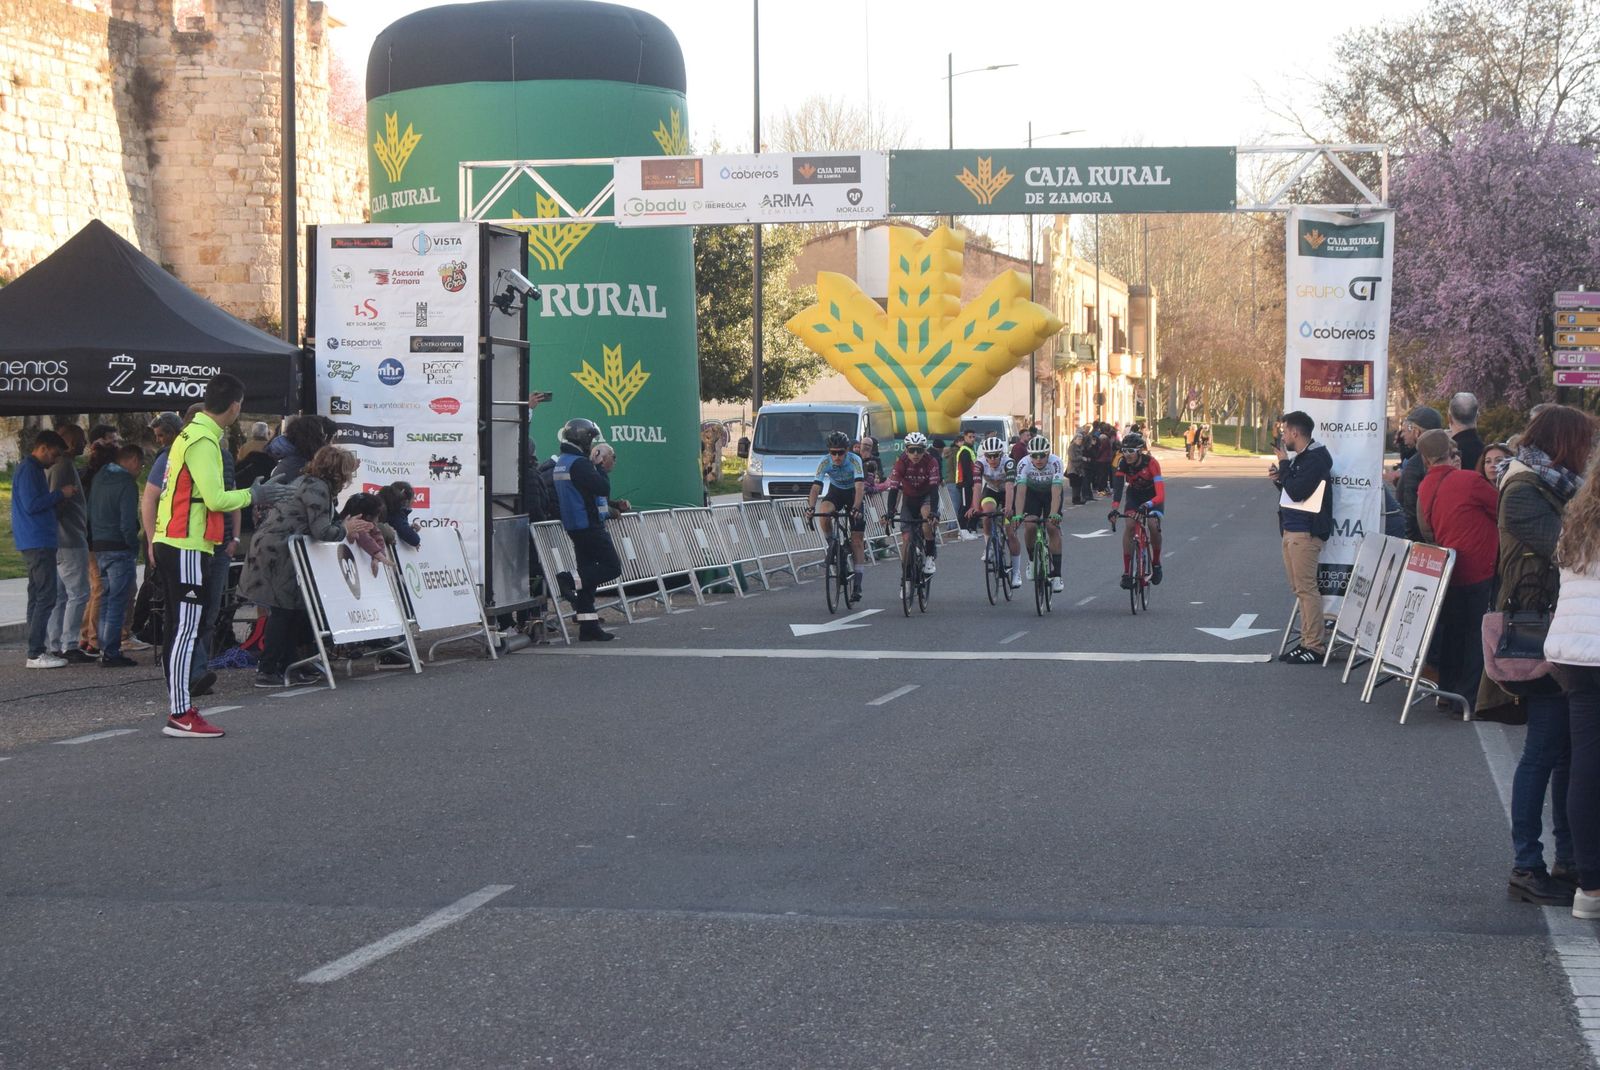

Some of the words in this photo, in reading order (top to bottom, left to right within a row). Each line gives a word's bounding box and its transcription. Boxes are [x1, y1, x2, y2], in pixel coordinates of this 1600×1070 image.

[730, 170, 779, 180] cobreros
[833, 165, 857, 174] RURAL
[1024, 166, 1082, 187] CAJA
[1087, 165, 1171, 186] RURAL
[371, 193, 389, 214] CAJA
[391, 186, 441, 209] RURAL
[1024, 192, 1044, 205] DE
[1048, 191, 1114, 205] ZAMORA
[623, 197, 687, 217] Cobadu
[433, 237, 462, 246] VISTA
[1327, 236, 1348, 245] CAJA
[1349, 236, 1380, 245] RURAL
[391, 277, 421, 285] Zamora
[1296, 284, 1346, 299] GRUPO
[537, 282, 667, 318] RURAL
[1313, 326, 1376, 340] cobreros
[340, 338, 383, 347] Espabrok
[422, 362, 451, 374] Puente
[426, 373, 453, 385] Piedra
[143, 380, 206, 398] ZAMOR
[1320, 422, 1378, 432] MORALEJO
[362, 428, 389, 440] baños
[610, 425, 667, 443] RURAL
[366, 464, 411, 475] TOMASITA
[421, 564, 471, 590] IBEREÓLICA
[347, 608, 380, 624] MORALEJO
